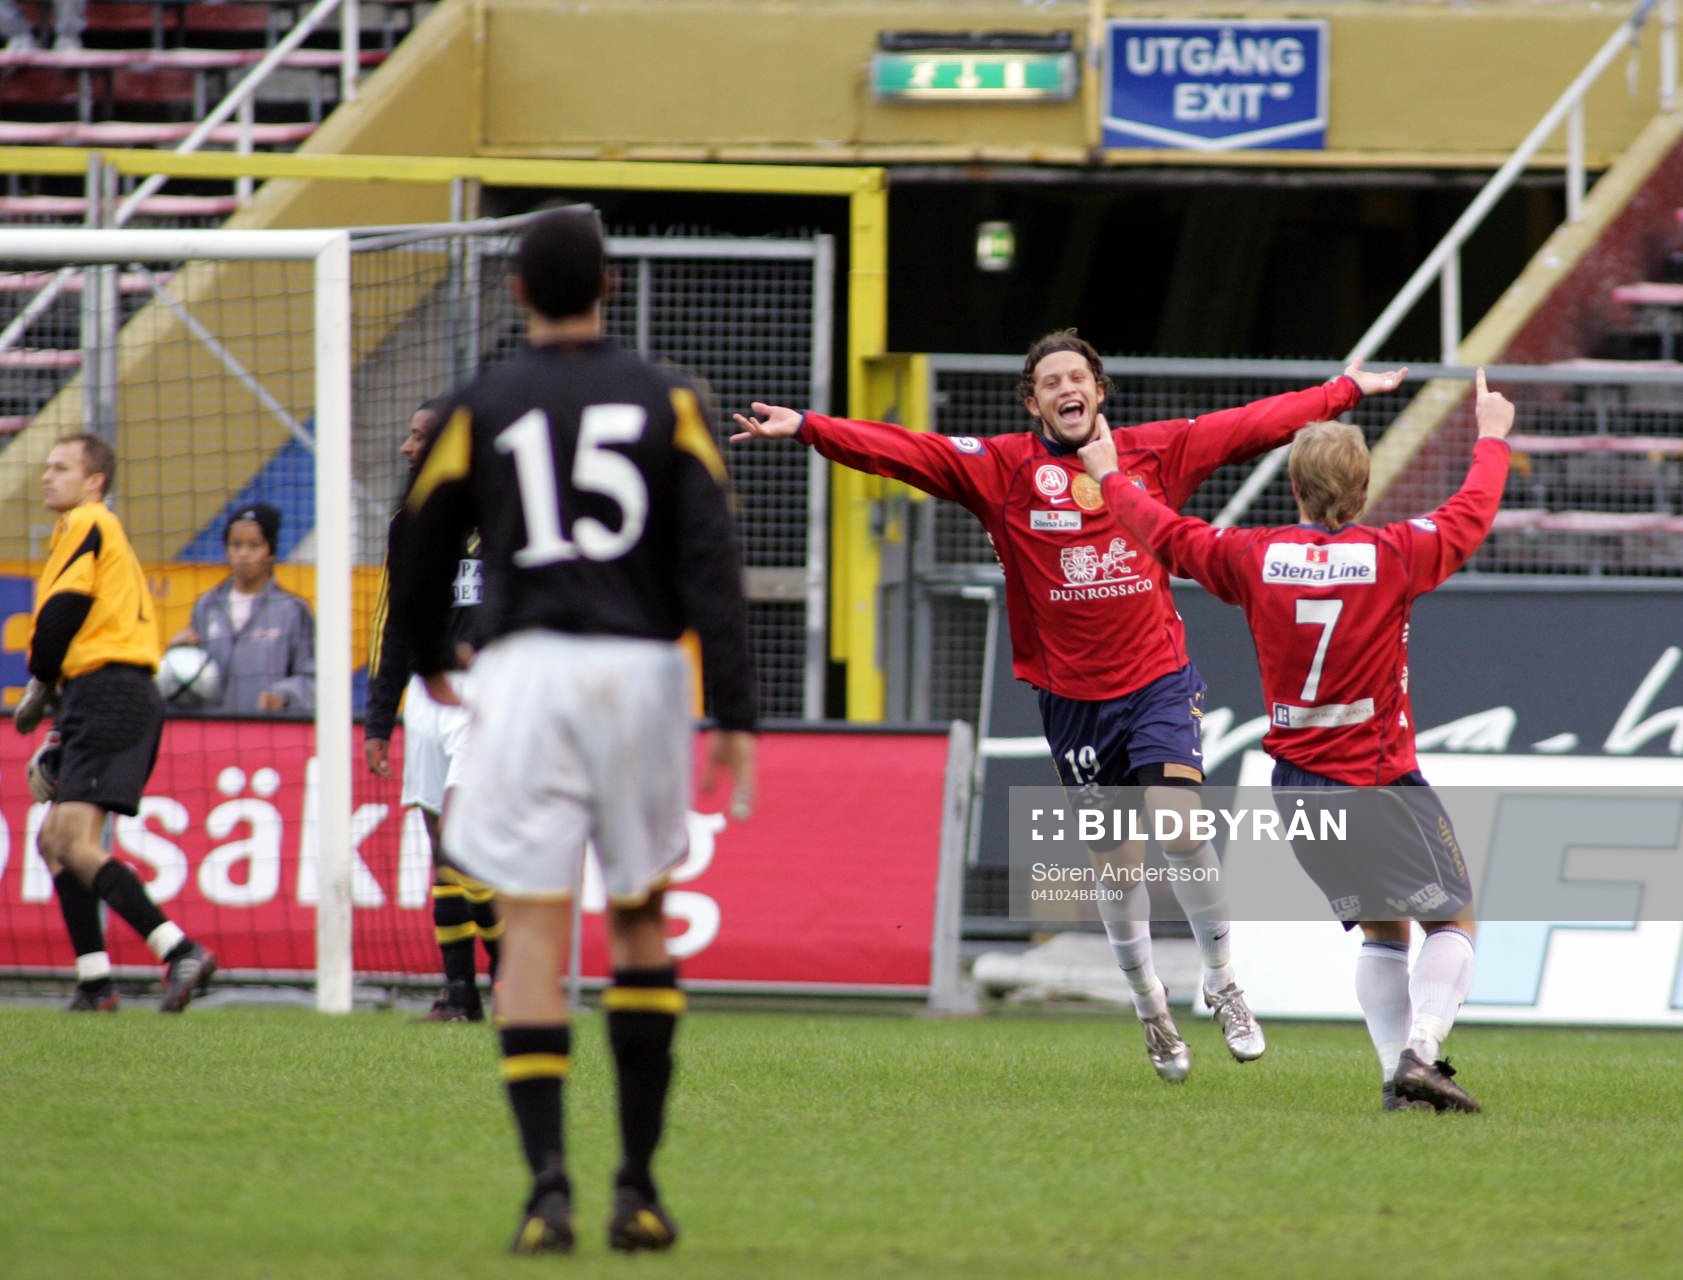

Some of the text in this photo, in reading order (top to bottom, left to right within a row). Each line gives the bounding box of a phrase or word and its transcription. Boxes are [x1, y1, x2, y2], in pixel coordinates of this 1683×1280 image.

[1126, 28, 1305, 76] UTGÅNG
[1173, 83, 1265, 121] EXIT
[494, 403, 648, 568] 15
[1049, 579, 1153, 601] DUNROSS&CO
[1268, 561, 1370, 580] Stena Line
[1296, 599, 1343, 701] 7
[1064, 745, 1101, 784] 19
